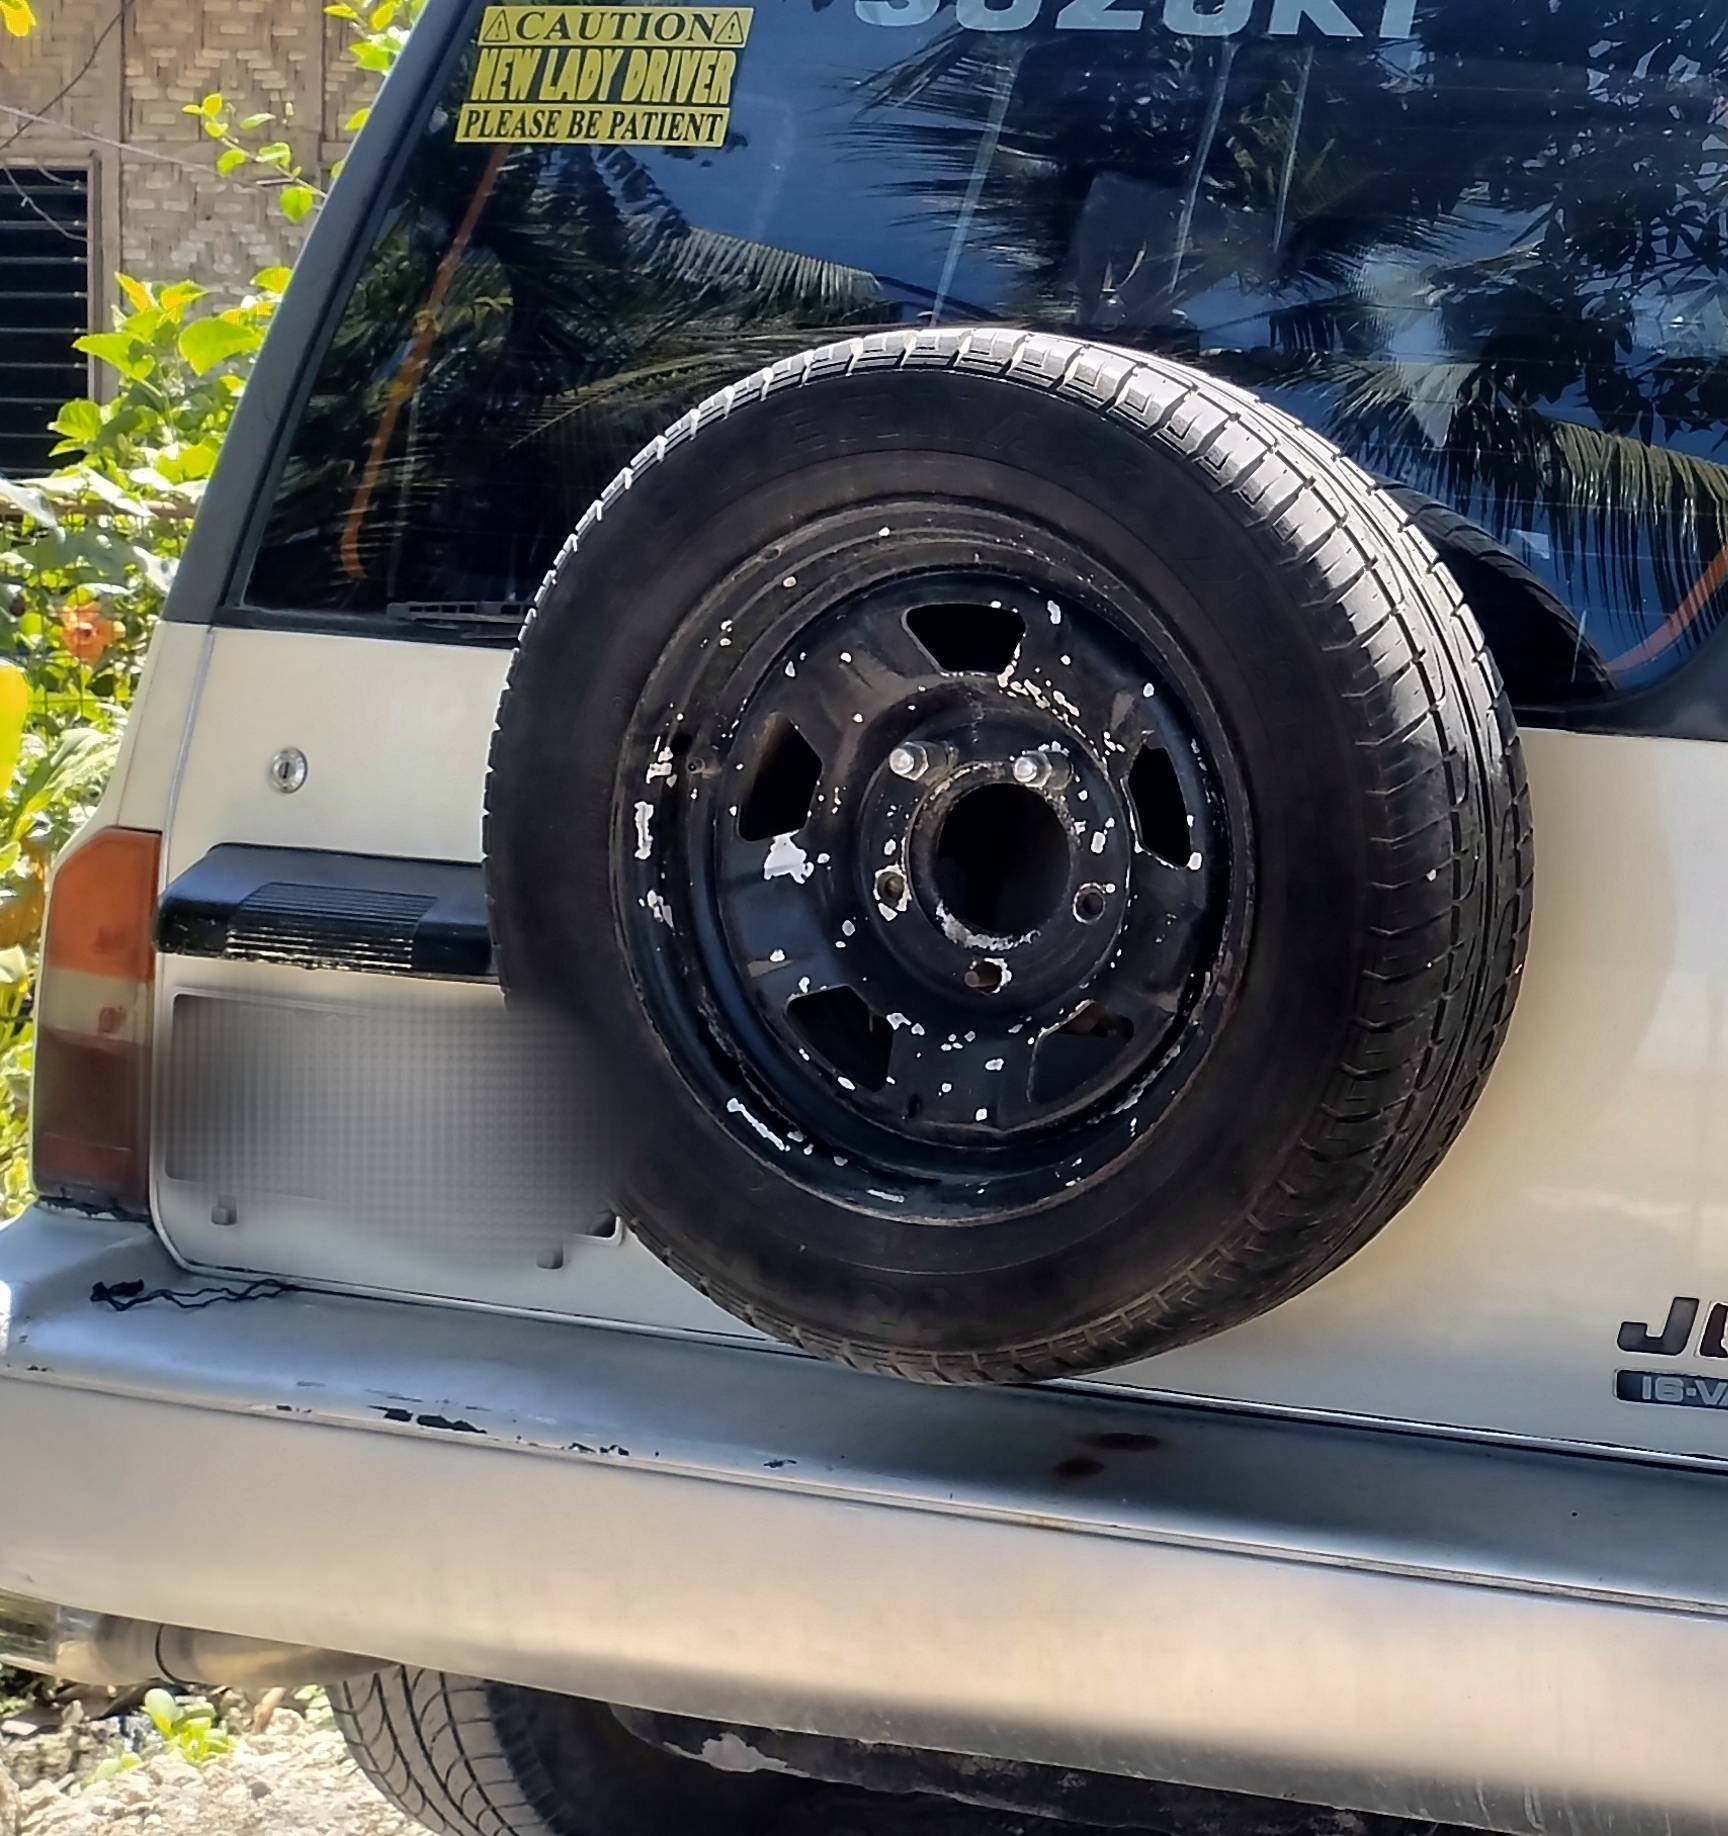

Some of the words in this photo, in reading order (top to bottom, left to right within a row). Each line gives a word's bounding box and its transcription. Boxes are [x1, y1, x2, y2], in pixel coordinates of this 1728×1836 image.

[515, 11, 720, 42] CAUTION
[470, 47, 540, 101] NEW
[538, 48, 624, 102] LADY
[621, 50, 737, 105] DRIVER
[464, 109, 562, 139] PLEASE
[569, 111, 602, 140] BE
[608, 112, 723, 143] PATIENT
